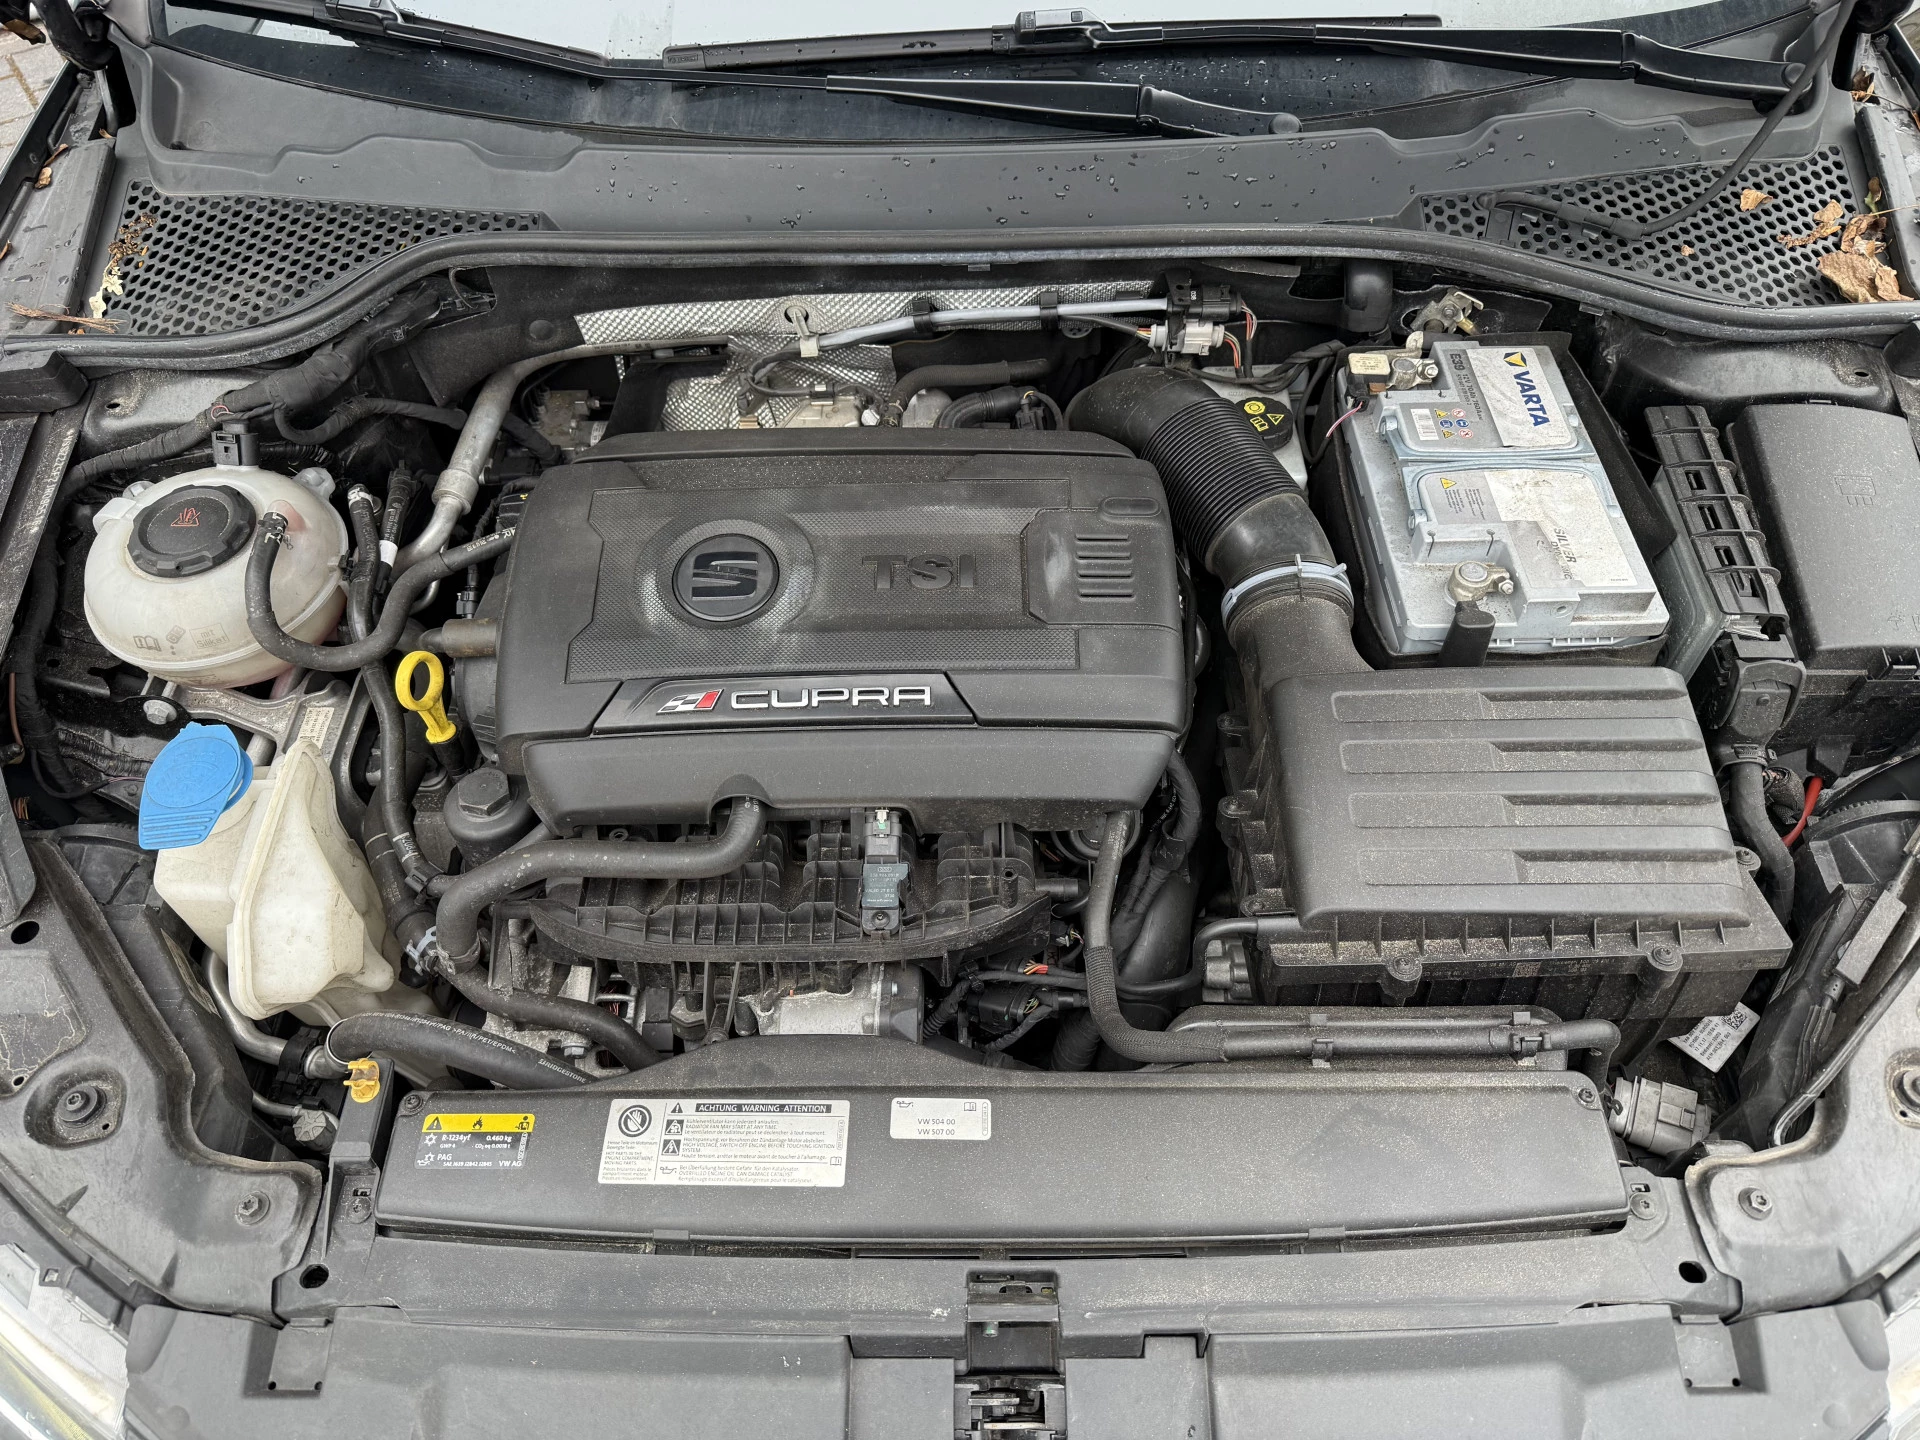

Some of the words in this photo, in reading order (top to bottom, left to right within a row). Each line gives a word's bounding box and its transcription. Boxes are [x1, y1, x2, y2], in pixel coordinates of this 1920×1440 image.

[1514, 370, 1550, 426] VARTA
[1554, 528, 1577, 563] SILVER
[862, 554, 976, 591] TSI
[197, 636, 227, 648] Silikat
[201, 630, 215, 638] mit
[731, 686, 932, 709] CUPRA
[442, 1134, 472, 1143] R-1234yf
